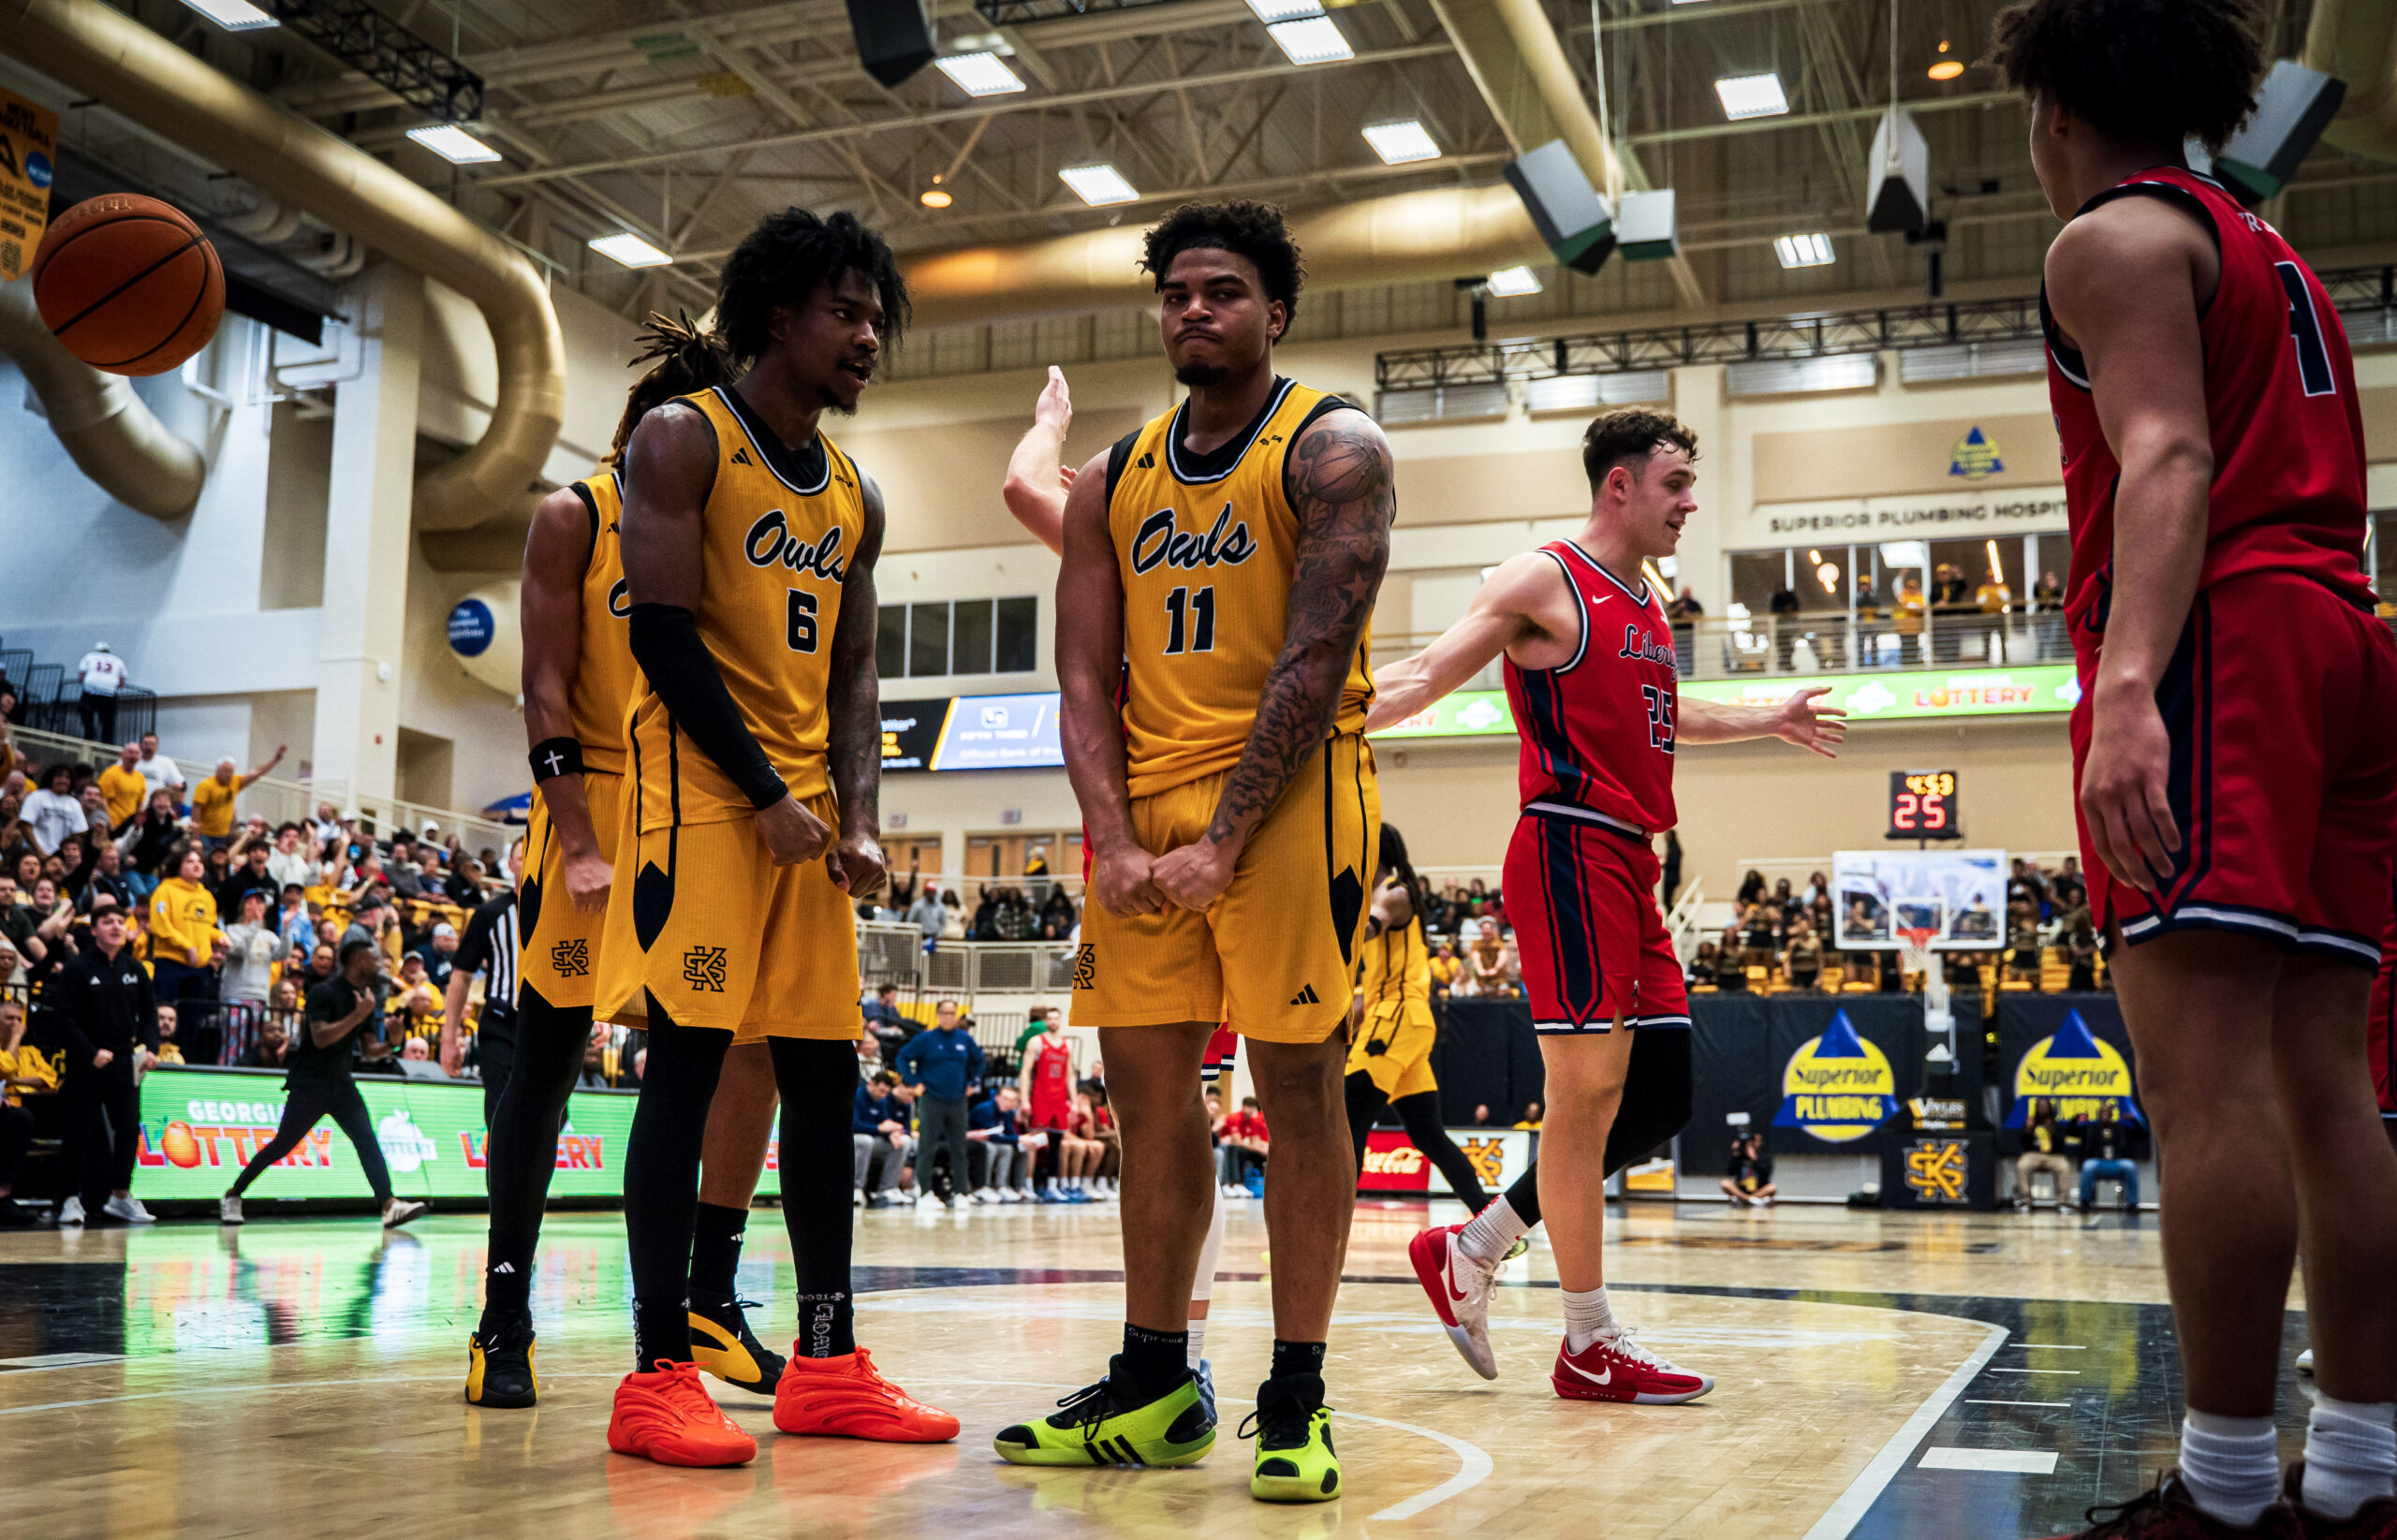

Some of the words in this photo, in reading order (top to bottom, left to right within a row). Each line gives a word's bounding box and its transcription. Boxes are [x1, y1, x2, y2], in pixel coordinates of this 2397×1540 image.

[1770, 513, 1870, 534] SUPERIOR
[1878, 506, 1986, 526] PLUMBING
[1994, 500, 2067, 518] HOSPIT
[743, 508, 843, 584] Owls
[1131, 500, 1257, 577] Owls
[787, 587, 818, 654] 6
[1163, 585, 1215, 655] 11
[1914, 686, 2034, 709] LOTTERY
[1641, 683, 1675, 755] 25
[1894, 793, 1946, 829] 25
[1791, 1062, 1882, 1093] Superior
[2023, 1062, 2119, 1093] Superior
[1795, 1096, 1883, 1121] PLUMBING
